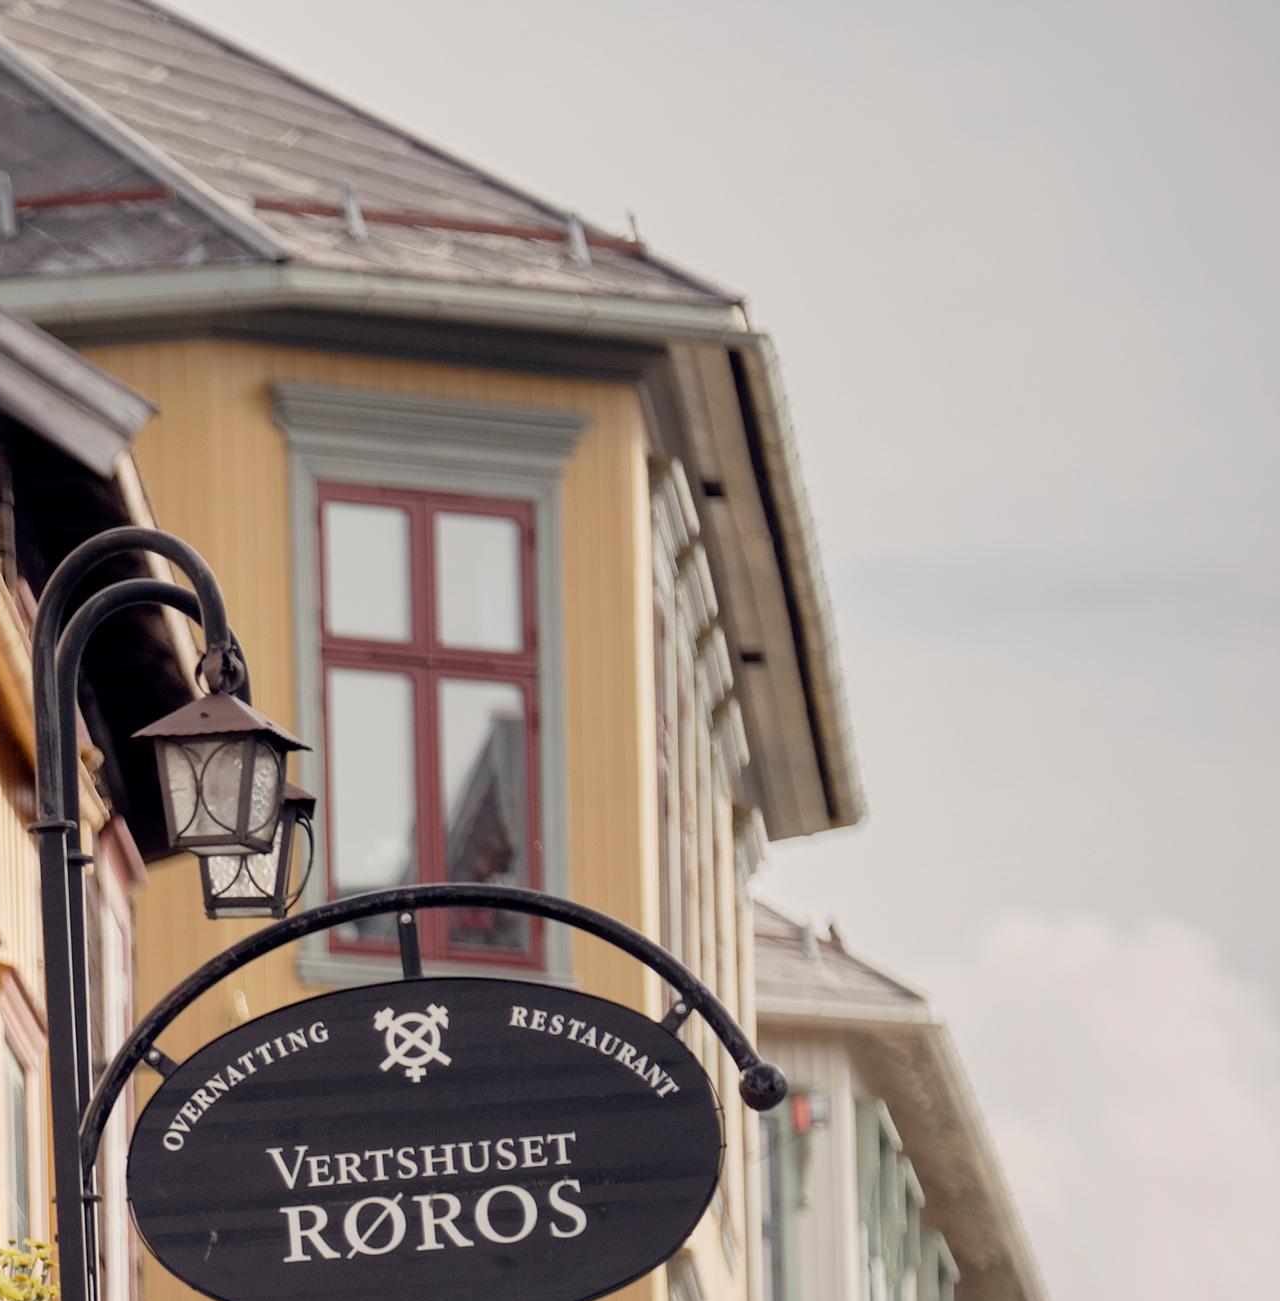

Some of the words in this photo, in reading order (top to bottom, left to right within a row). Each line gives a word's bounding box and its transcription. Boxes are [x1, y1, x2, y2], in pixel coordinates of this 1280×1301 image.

[162, 1021, 330, 1152] OVERNATTING
[509, 1005, 680, 1099] RESTAURANT
[279, 1178, 588, 1264] RØROS
